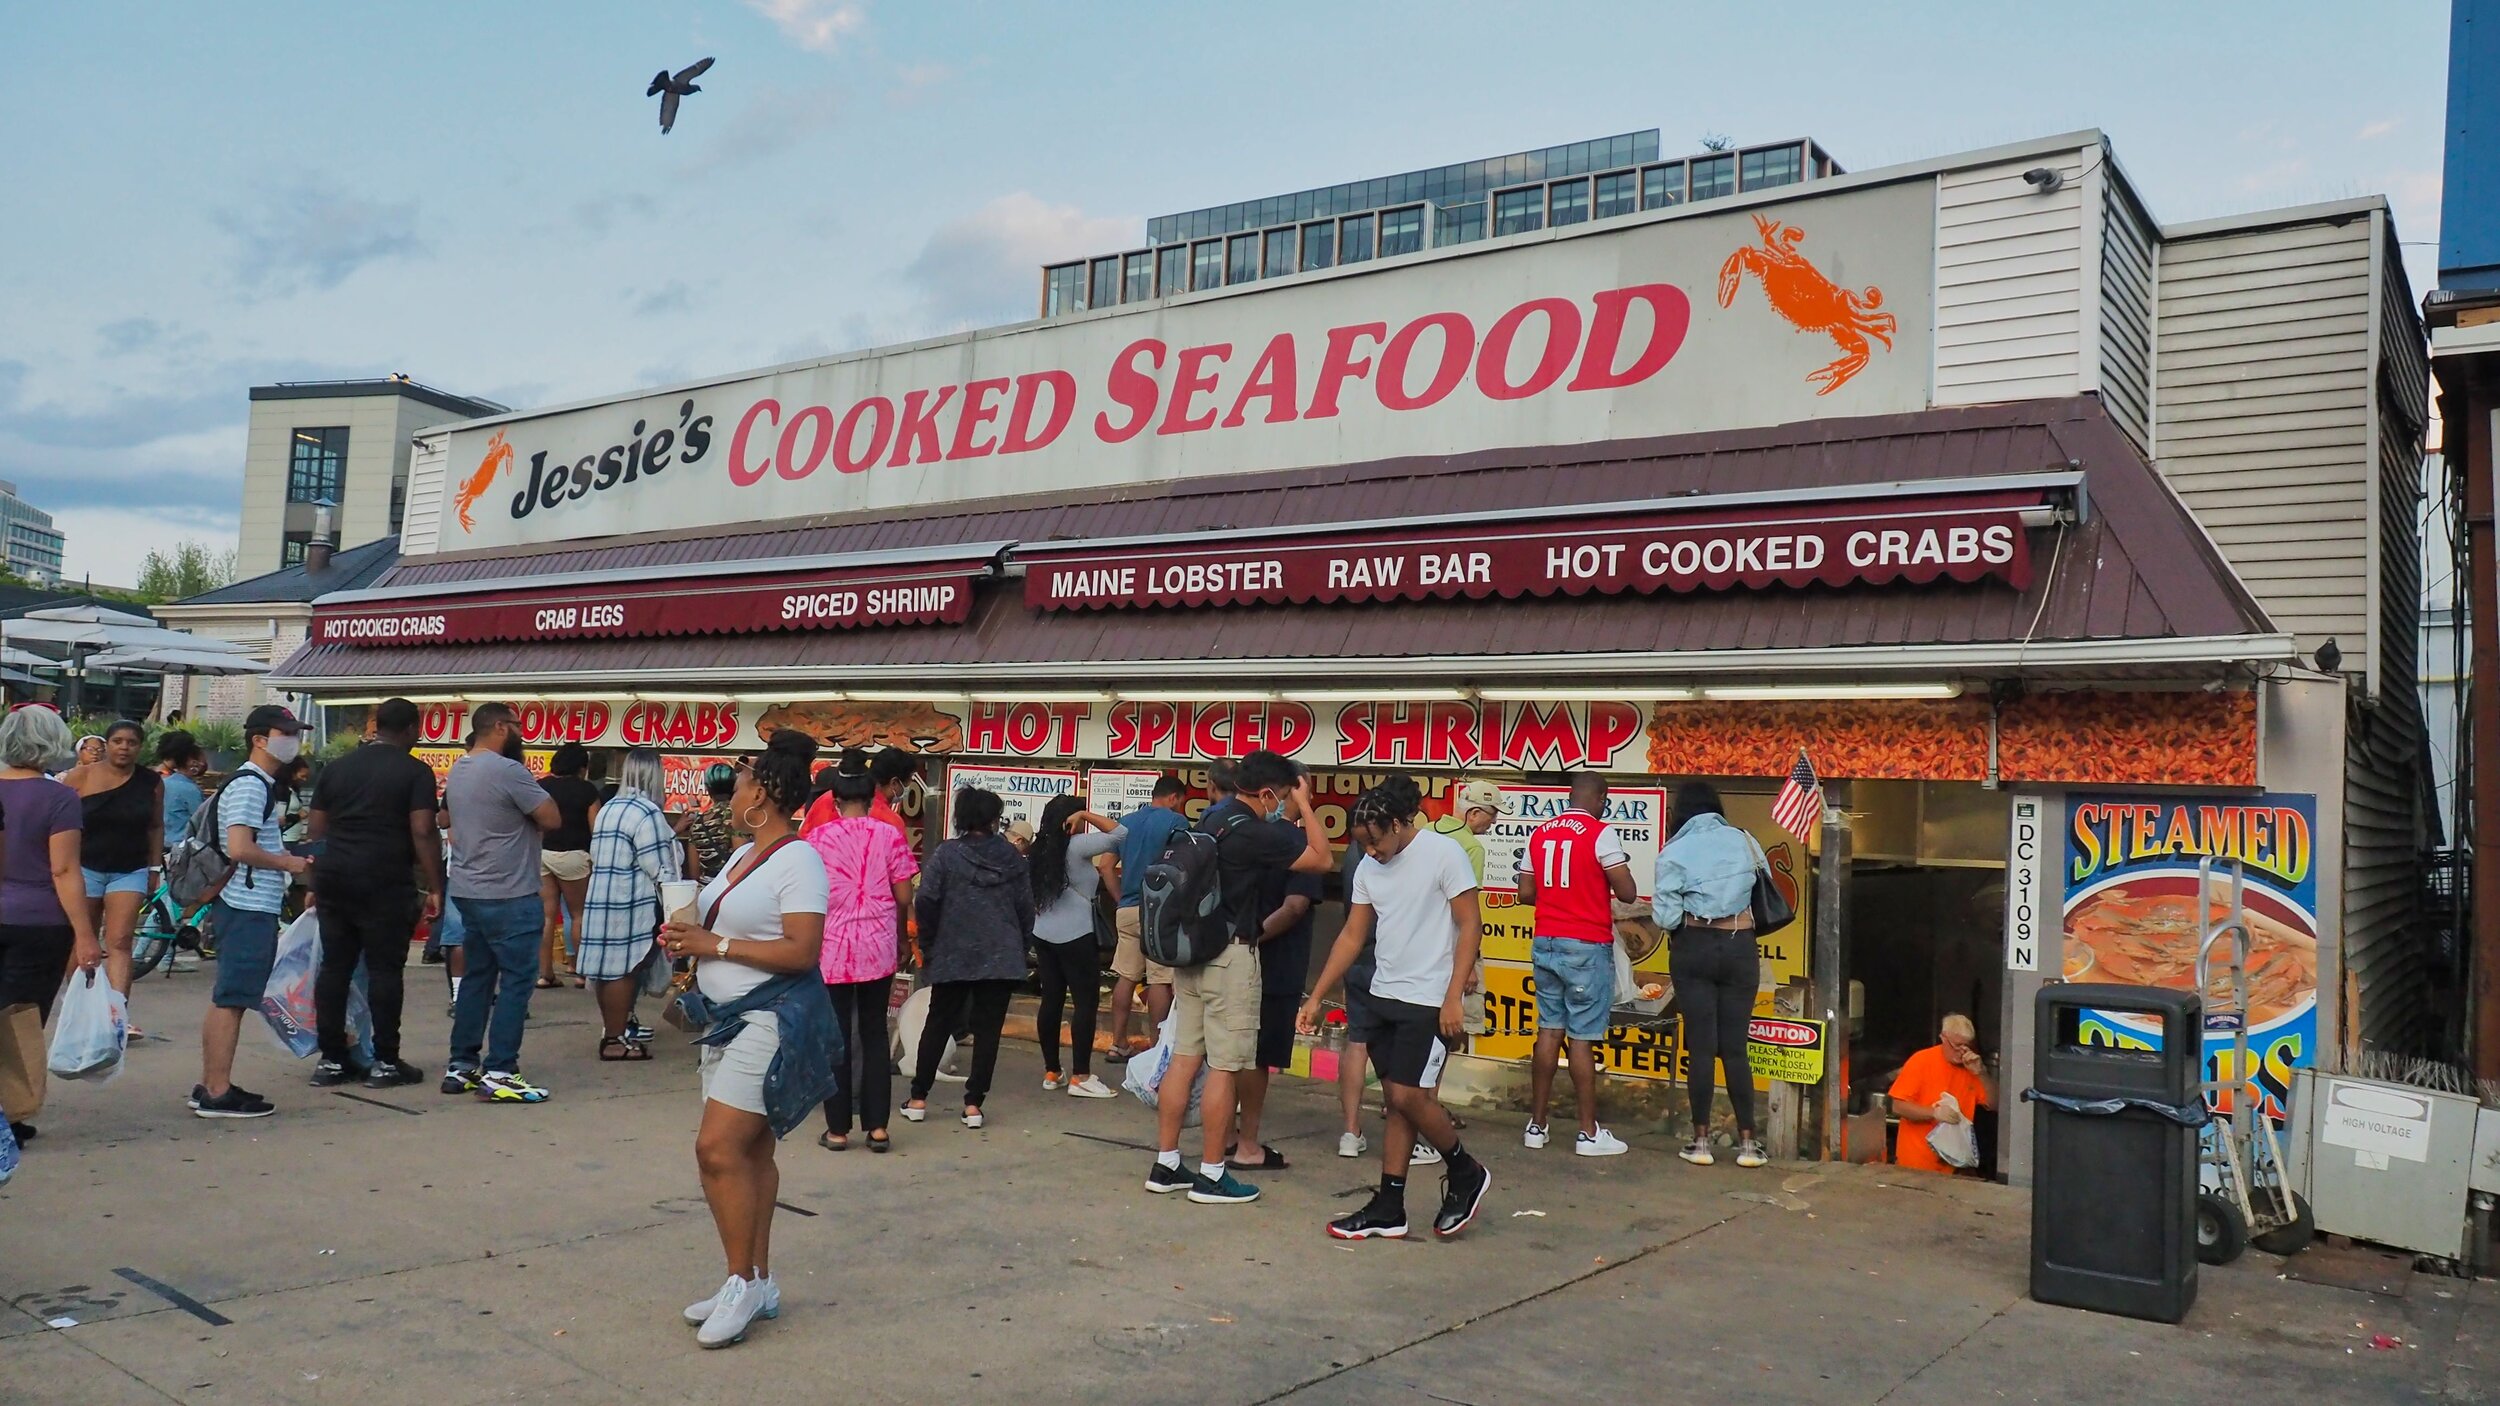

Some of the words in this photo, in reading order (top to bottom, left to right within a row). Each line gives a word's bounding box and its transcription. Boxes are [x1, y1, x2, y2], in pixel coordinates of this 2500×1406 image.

[511, 399, 713, 520] Jessie's
[728, 369, 1077, 487] COOKED
[1094, 283, 1691, 444] SEAFOOD
[1546, 544, 1626, 580] HOT
[1642, 534, 1825, 577] COOKED
[1845, 524, 2014, 568] CRABS
[1051, 567, 1136, 599] MAINE
[1146, 560, 1284, 595] LOBSTER
[1328, 556, 1405, 588] RAW
[1419, 552, 1492, 586] BAR
[781, 590, 858, 620] SPICED
[866, 585, 956, 616] SHRIMP
[323, 619, 350, 639] HOT
[350, 617, 400, 638] COOKED
[401, 615, 446, 637] CRABS
[535, 607, 577, 632] CRAB
[581, 604, 625, 628] LEGS
[418, 701, 469, 743] OT
[502, 700, 612, 745] OKED
[620, 700, 740, 749] CRABS
[966, 701, 1092, 757] HOT
[1107, 700, 1316, 760] SPICED
[1335, 700, 1643, 771] SHRIMP
[524, 755, 545, 771] ABS
[663, 768, 709, 796] LASKA
[1008, 775, 1073, 794] SHRIMP
[1495, 824, 1538, 837] CLAM
[1615, 828, 1650, 842] TERS
[2074, 802, 2311, 884] STEAMED
[1542, 839, 1573, 889] 11
[1511, 925, 1533, 939] TH
[1748, 1023, 1810, 1042] CAUTION
[1748, 1056, 1777, 1067] ILDREN
[1780, 1059, 1814, 1071] CLOSELY
[1749, 1045, 1777, 1056] PLEASE
[1769, 1069, 1819, 1082] WATERFRONT
[2342, 1116, 2365, 1129] HIGH
[2368, 1122, 2413, 1139] VOLTAGE
